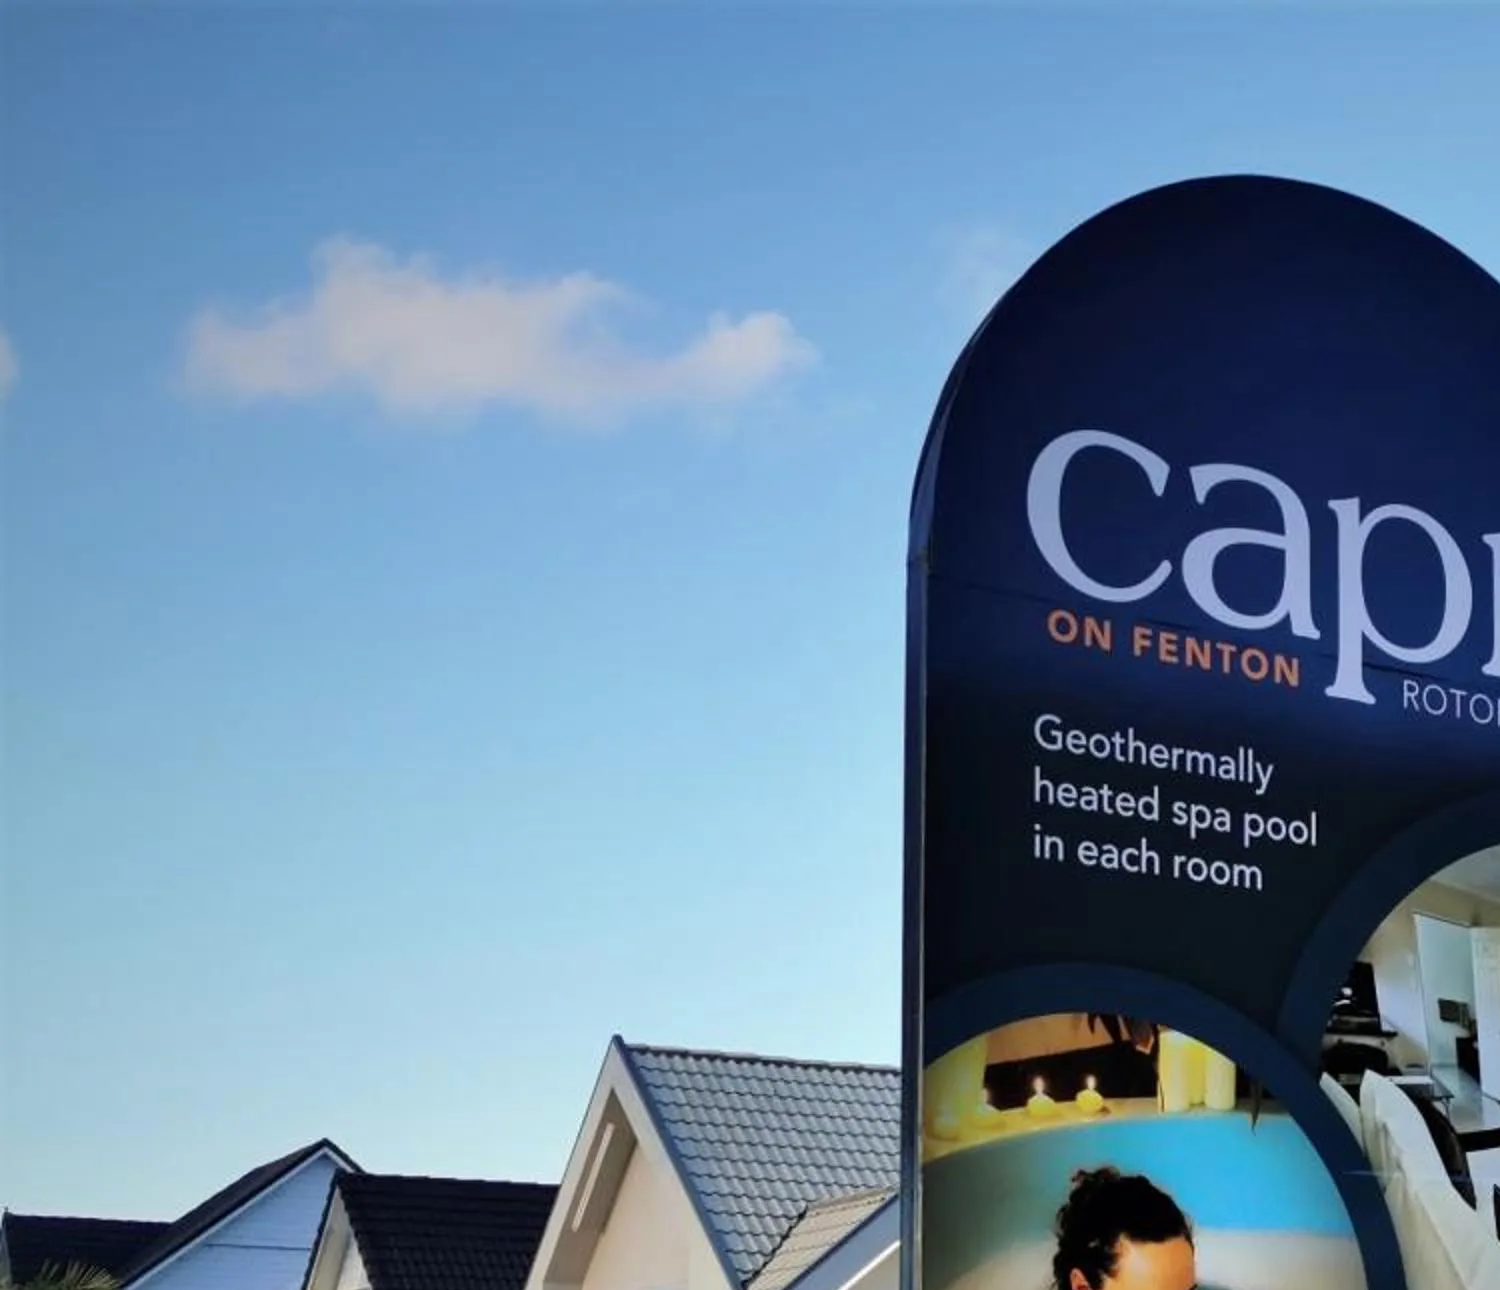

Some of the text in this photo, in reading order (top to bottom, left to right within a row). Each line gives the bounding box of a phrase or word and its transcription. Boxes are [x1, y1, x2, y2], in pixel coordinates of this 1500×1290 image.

[1048, 610, 1299, 687] ON FENTON
[1034, 713, 1275, 795] Geothermally
[1034, 764, 1318, 848] heated spa pool
[1034, 825, 1264, 891] in each room
